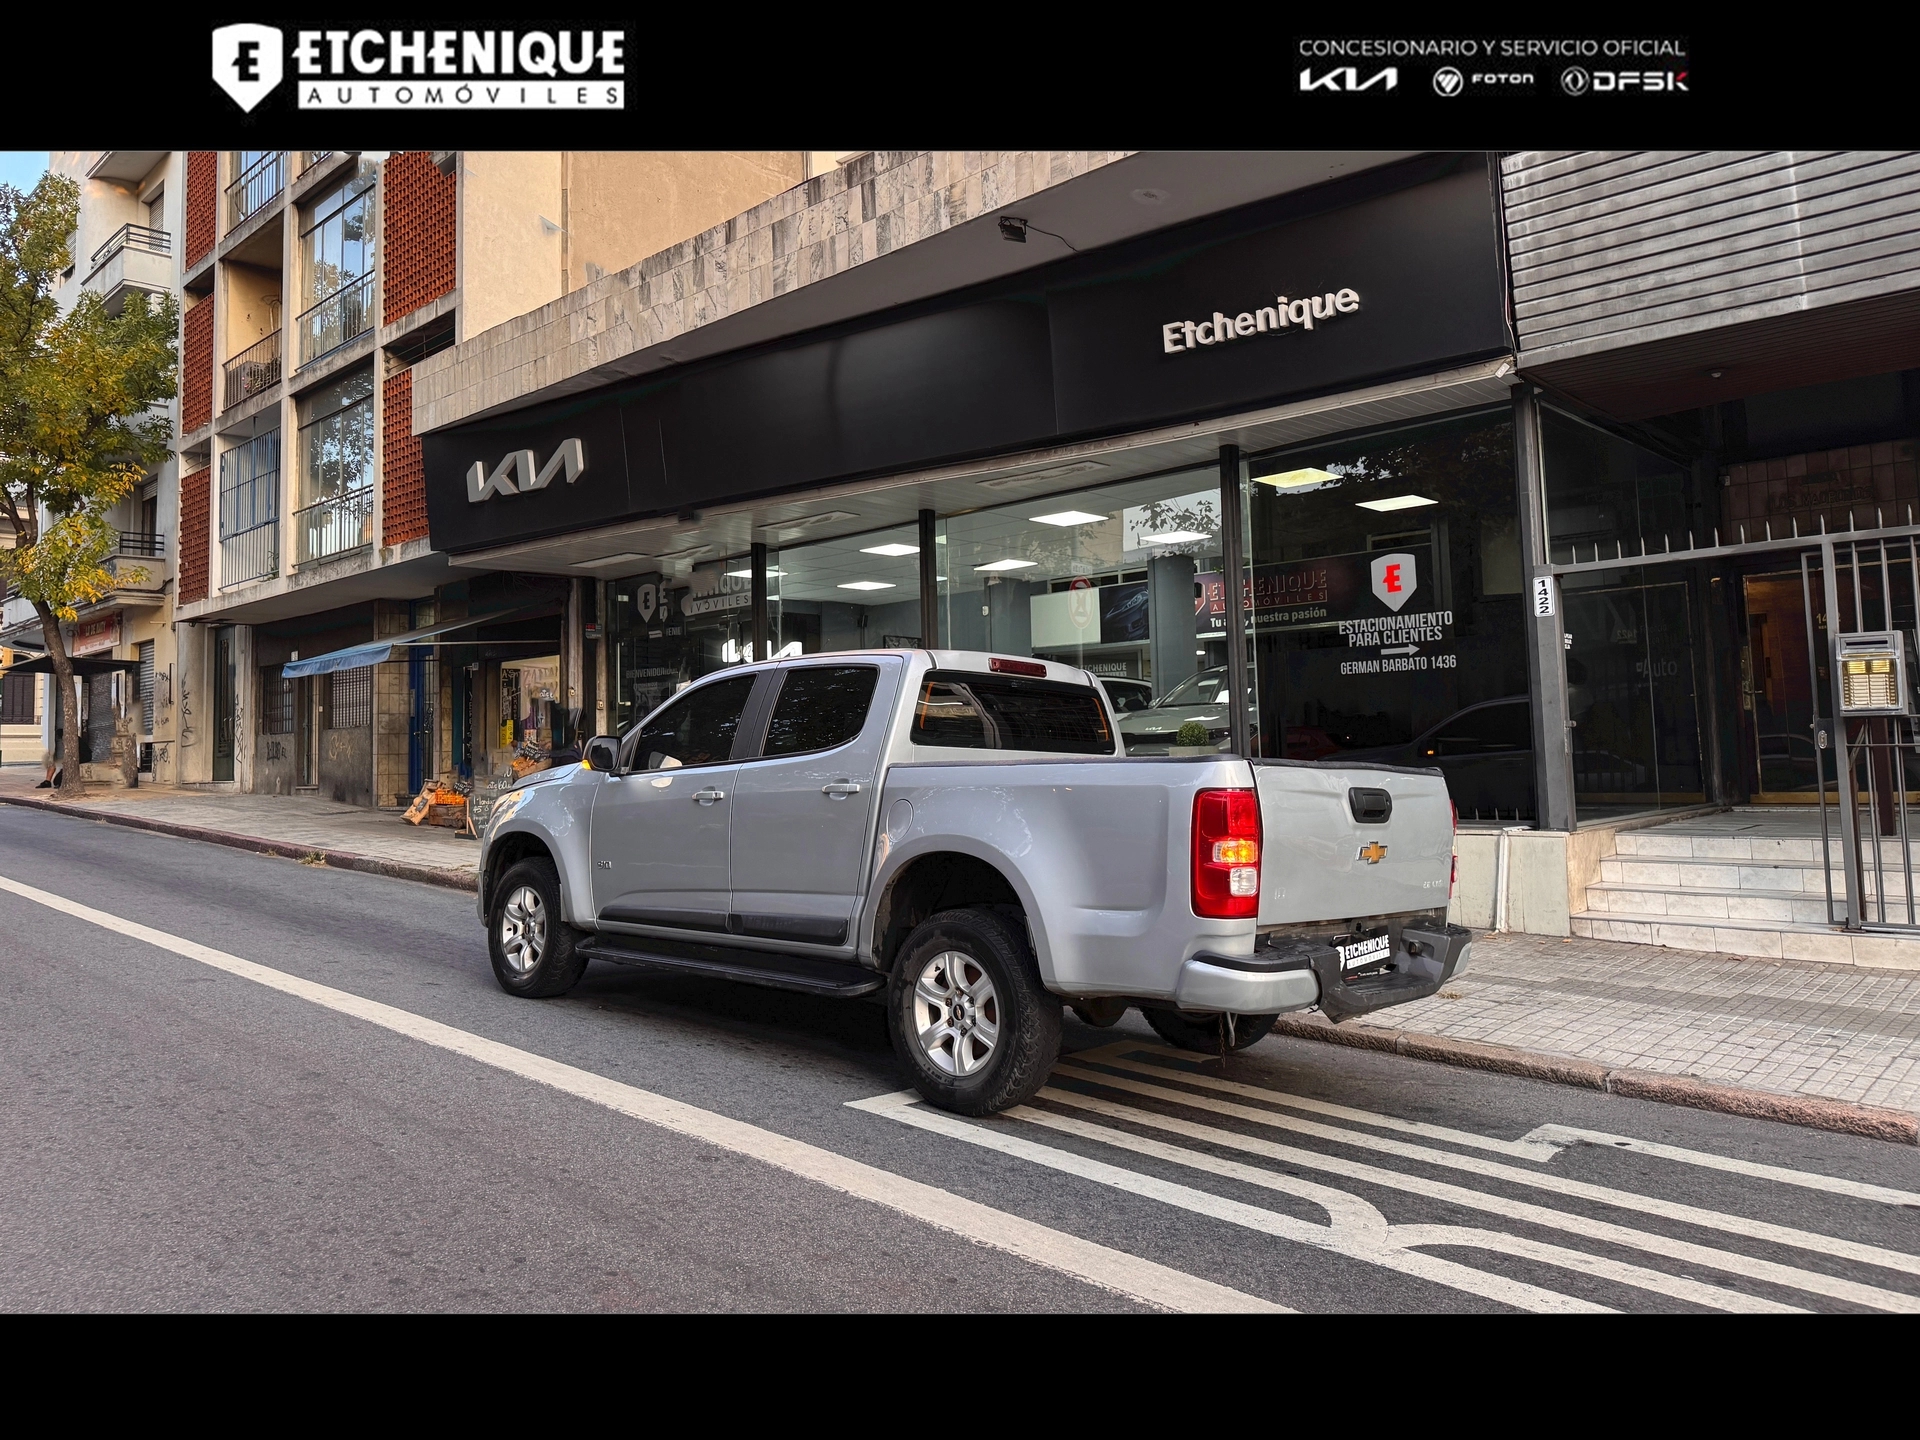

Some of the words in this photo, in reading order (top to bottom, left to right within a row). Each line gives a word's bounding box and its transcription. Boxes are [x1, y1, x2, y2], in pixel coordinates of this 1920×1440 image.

[1161, 287, 1361, 354] Etchenique
[465, 437, 585, 503] KIA
[1537, 578, 1551, 615] 1422
[1291, 606, 1327, 623] pasión
[1338, 610, 1454, 636] ESTACIONAMIENTO
[1348, 629, 1382, 648] PARA
[1383, 625, 1444, 646] CLIENTES
[1340, 658, 1381, 676] GERMAN
[1381, 656, 1428, 673] BARBATO
[1430, 654, 1457, 671] 1436
[1345, 934, 1390, 960] ETCHENIQUE
